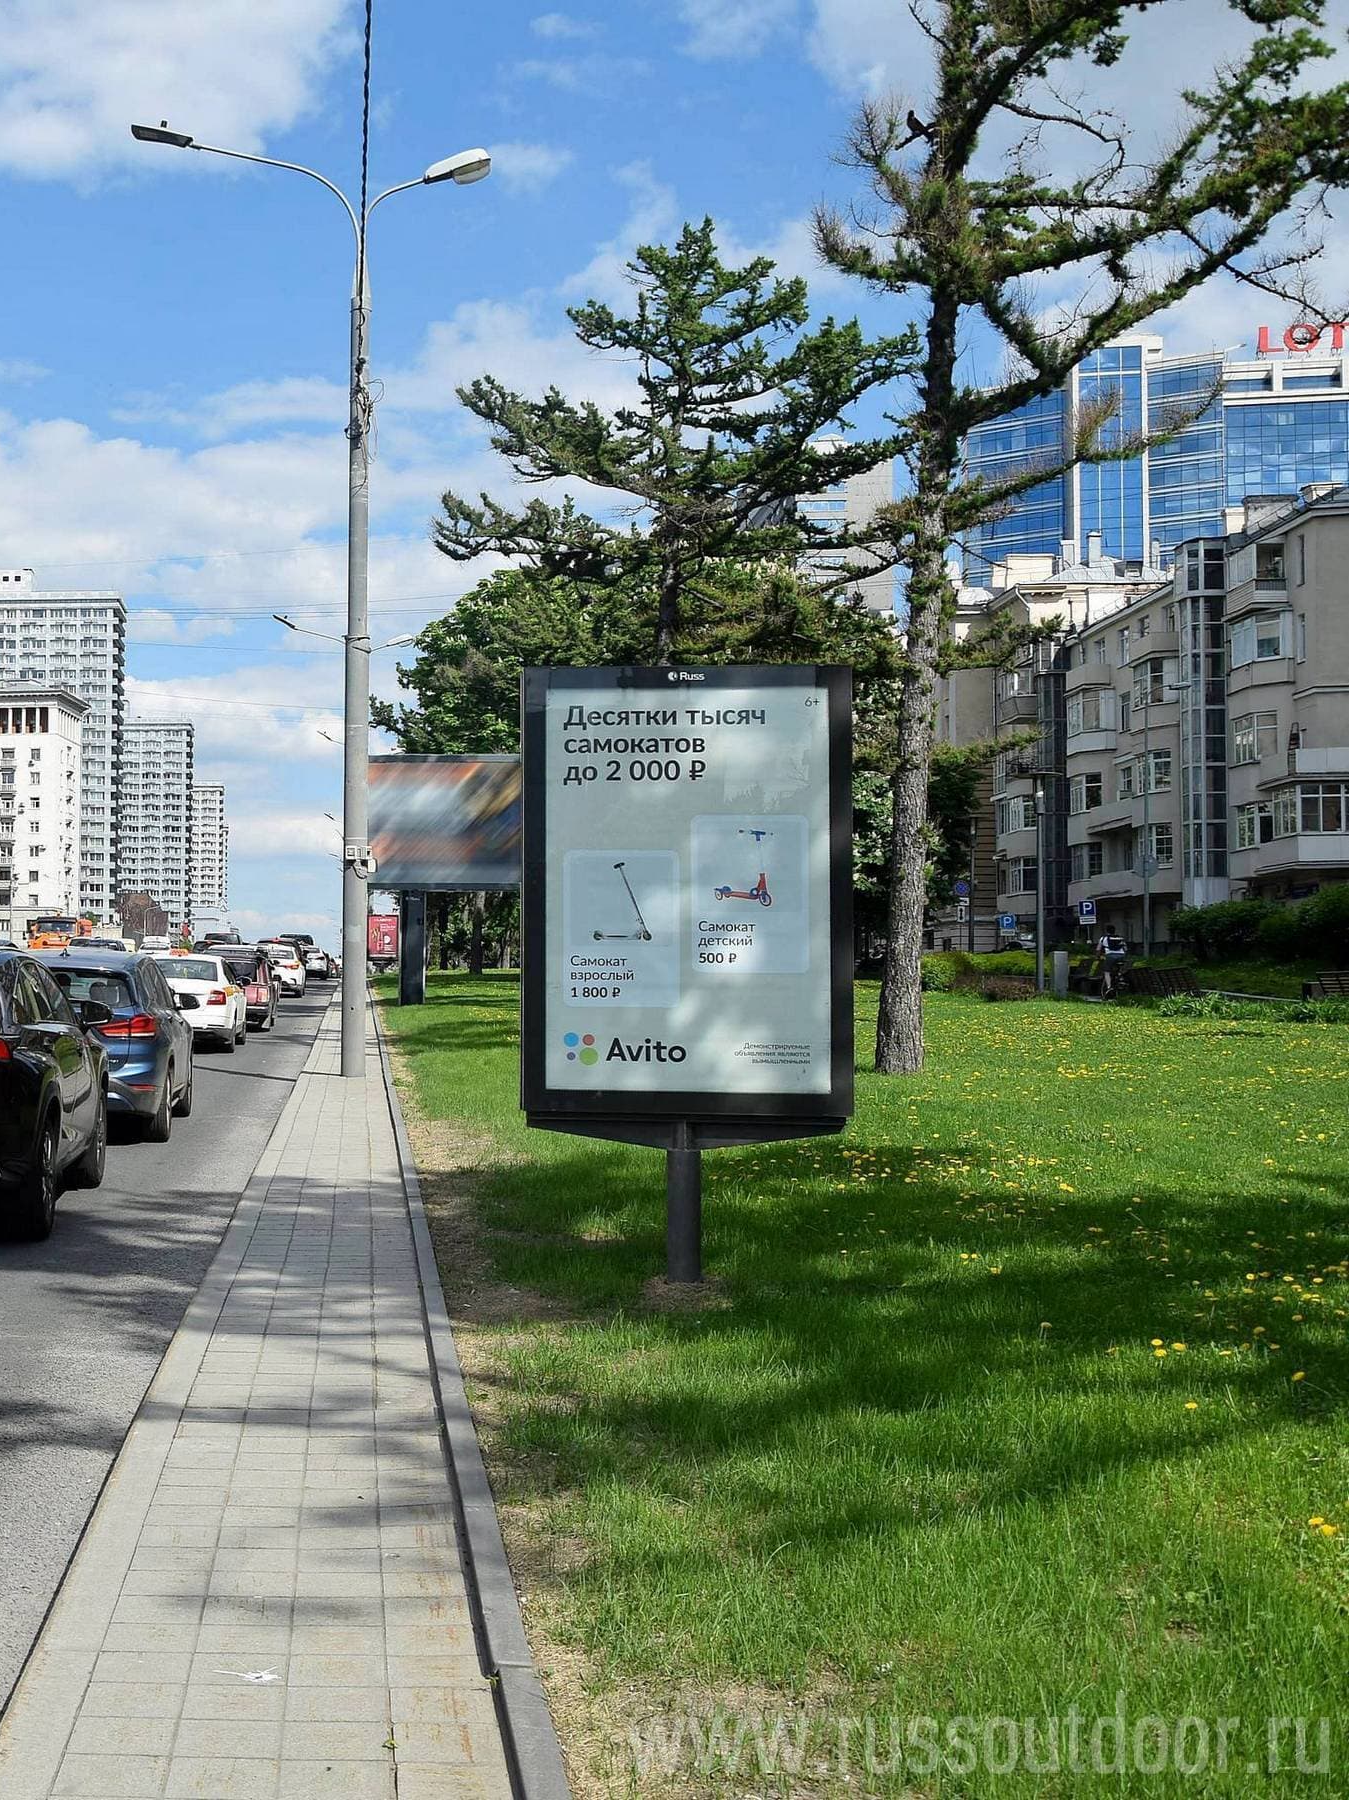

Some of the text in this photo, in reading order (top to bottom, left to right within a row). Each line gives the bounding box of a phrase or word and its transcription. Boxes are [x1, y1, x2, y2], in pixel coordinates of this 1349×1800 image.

[679, 671, 706, 681] Russ
[804, 696, 820, 707] 6+
[563, 705, 766, 731] Десятки тысяч
[564, 737, 705, 753] самокатов
[563, 766, 598, 785] до
[606, 760, 621, 781] 2
[629, 760, 681, 781] 000
[698, 920, 756, 932] Самокат
[698, 935, 753, 948] детский
[570, 955, 628, 967] Самокат
[699, 952, 724, 964] 500
[570, 970, 634, 983] взрослый
[571, 987, 578, 998] 1
[582, 986, 608, 998] 800
[605, 1037, 687, 1063] Avito
